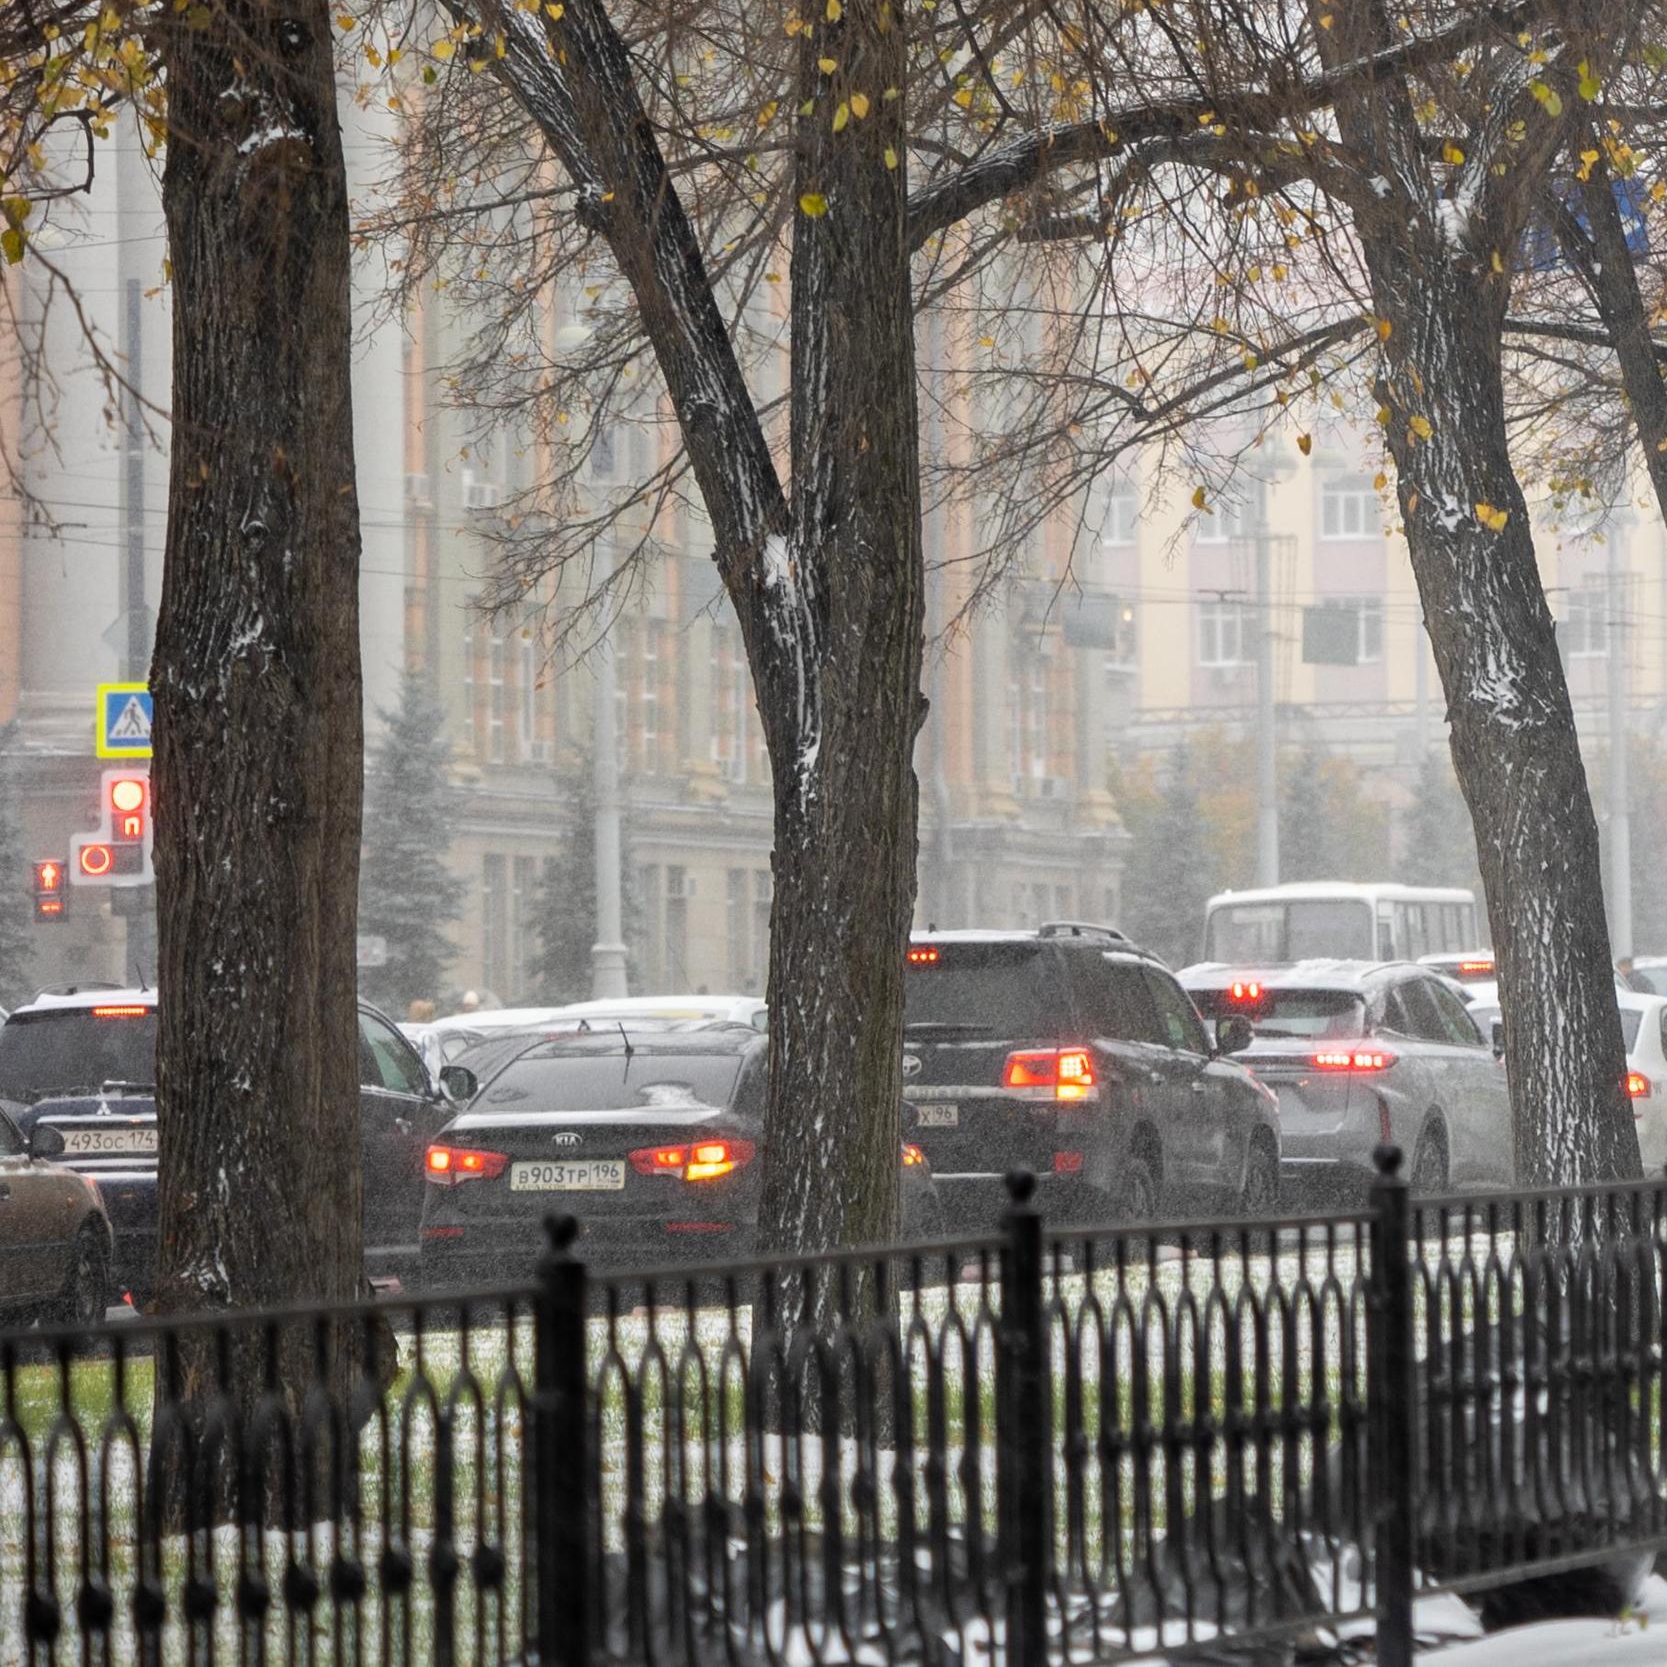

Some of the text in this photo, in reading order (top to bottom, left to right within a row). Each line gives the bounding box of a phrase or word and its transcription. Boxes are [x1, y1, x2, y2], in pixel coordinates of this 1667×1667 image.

[129, 1132, 154, 1145] 174
[518, 1164, 619, 1184] В903ТР 196
